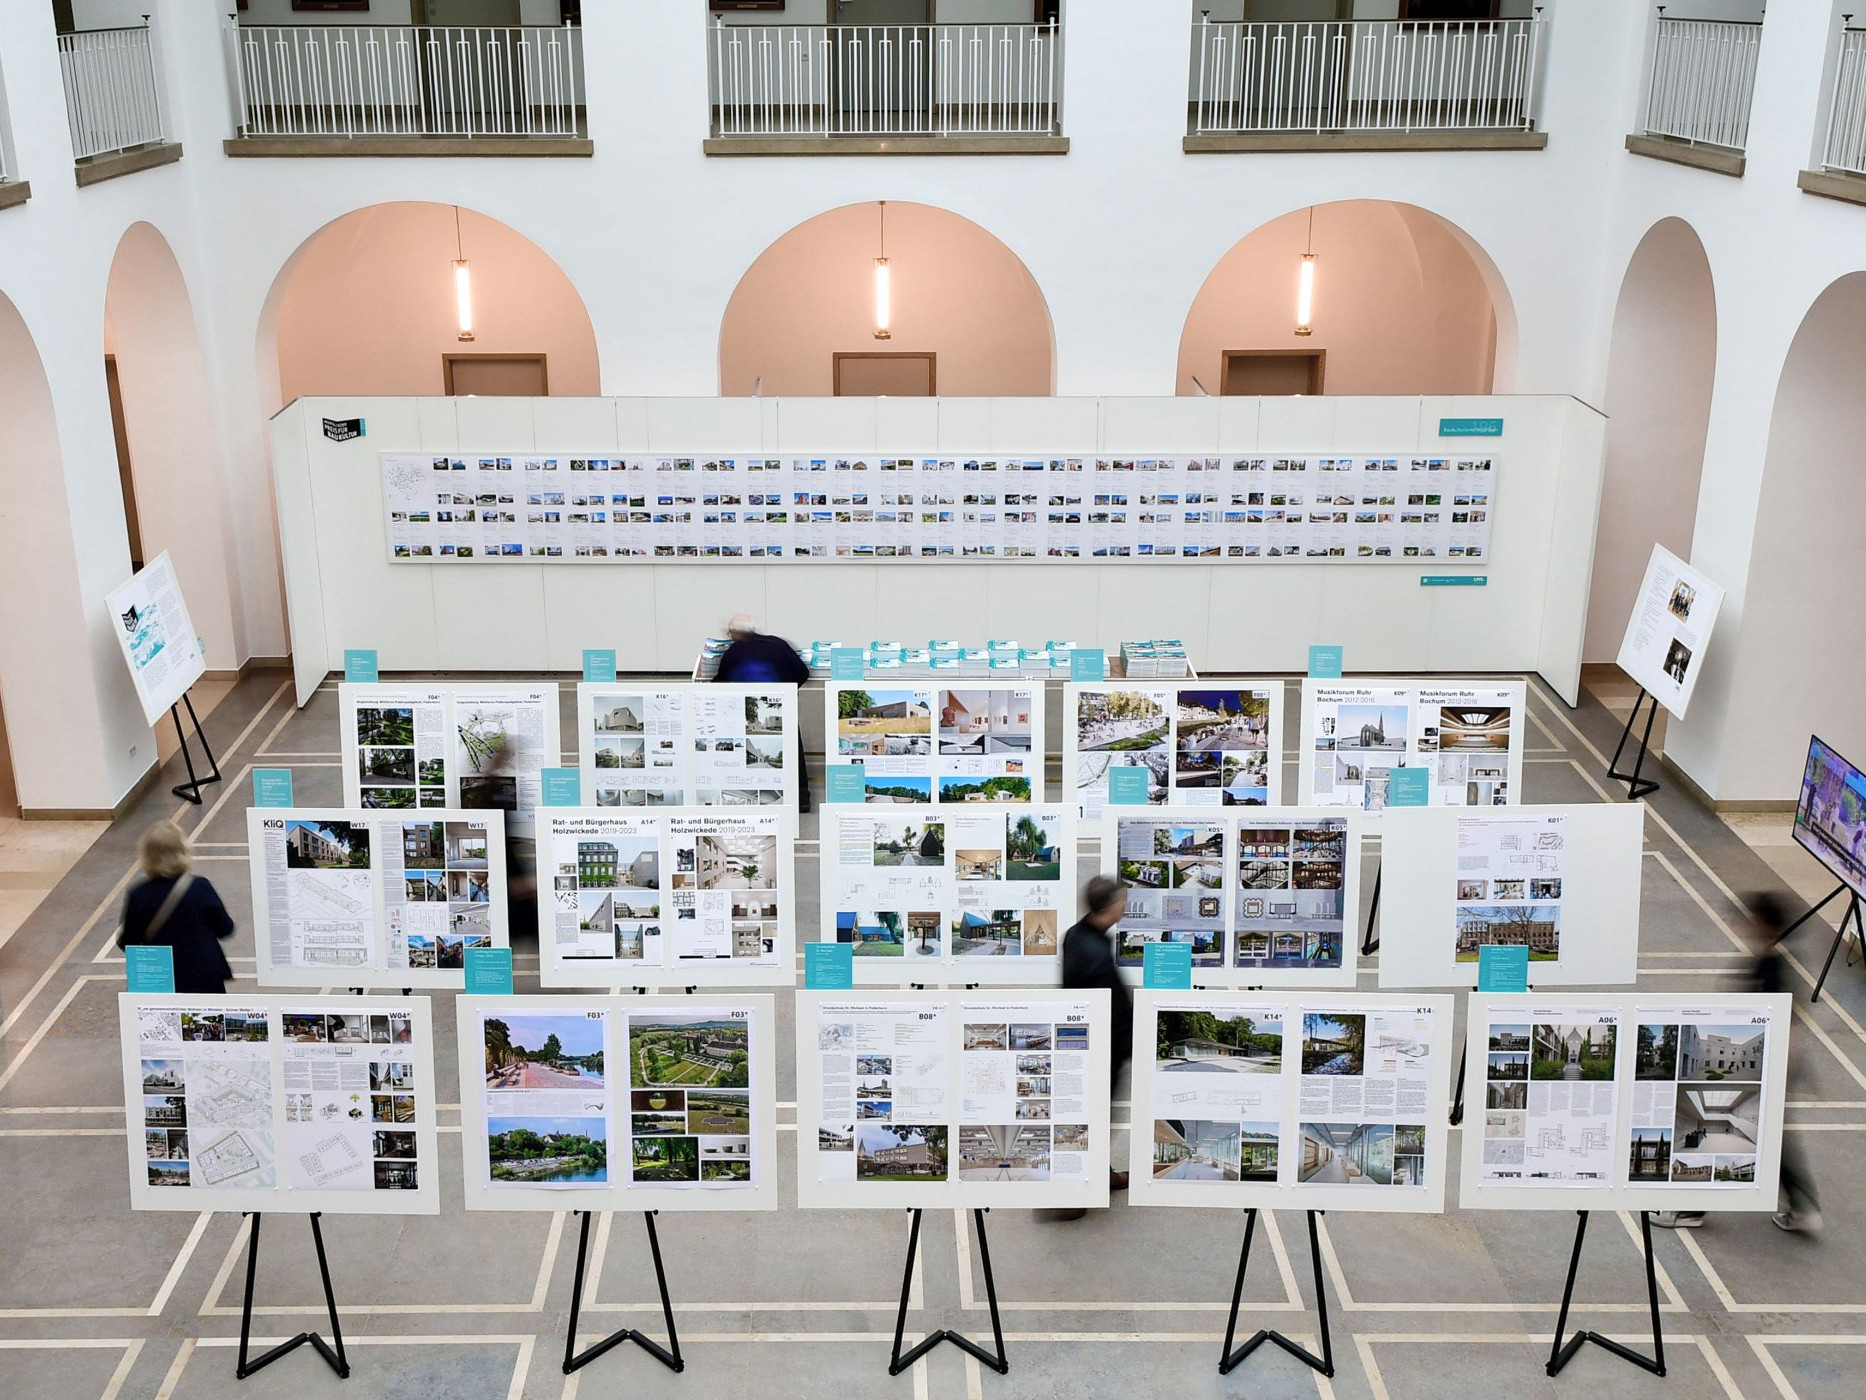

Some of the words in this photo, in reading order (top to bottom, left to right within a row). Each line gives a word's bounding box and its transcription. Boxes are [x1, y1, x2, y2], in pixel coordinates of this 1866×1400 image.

[263, 820, 284, 829] KliQ
[585, 819, 627, 827] Bürgerhaus
[704, 818, 745, 826] Bürgerhaus
